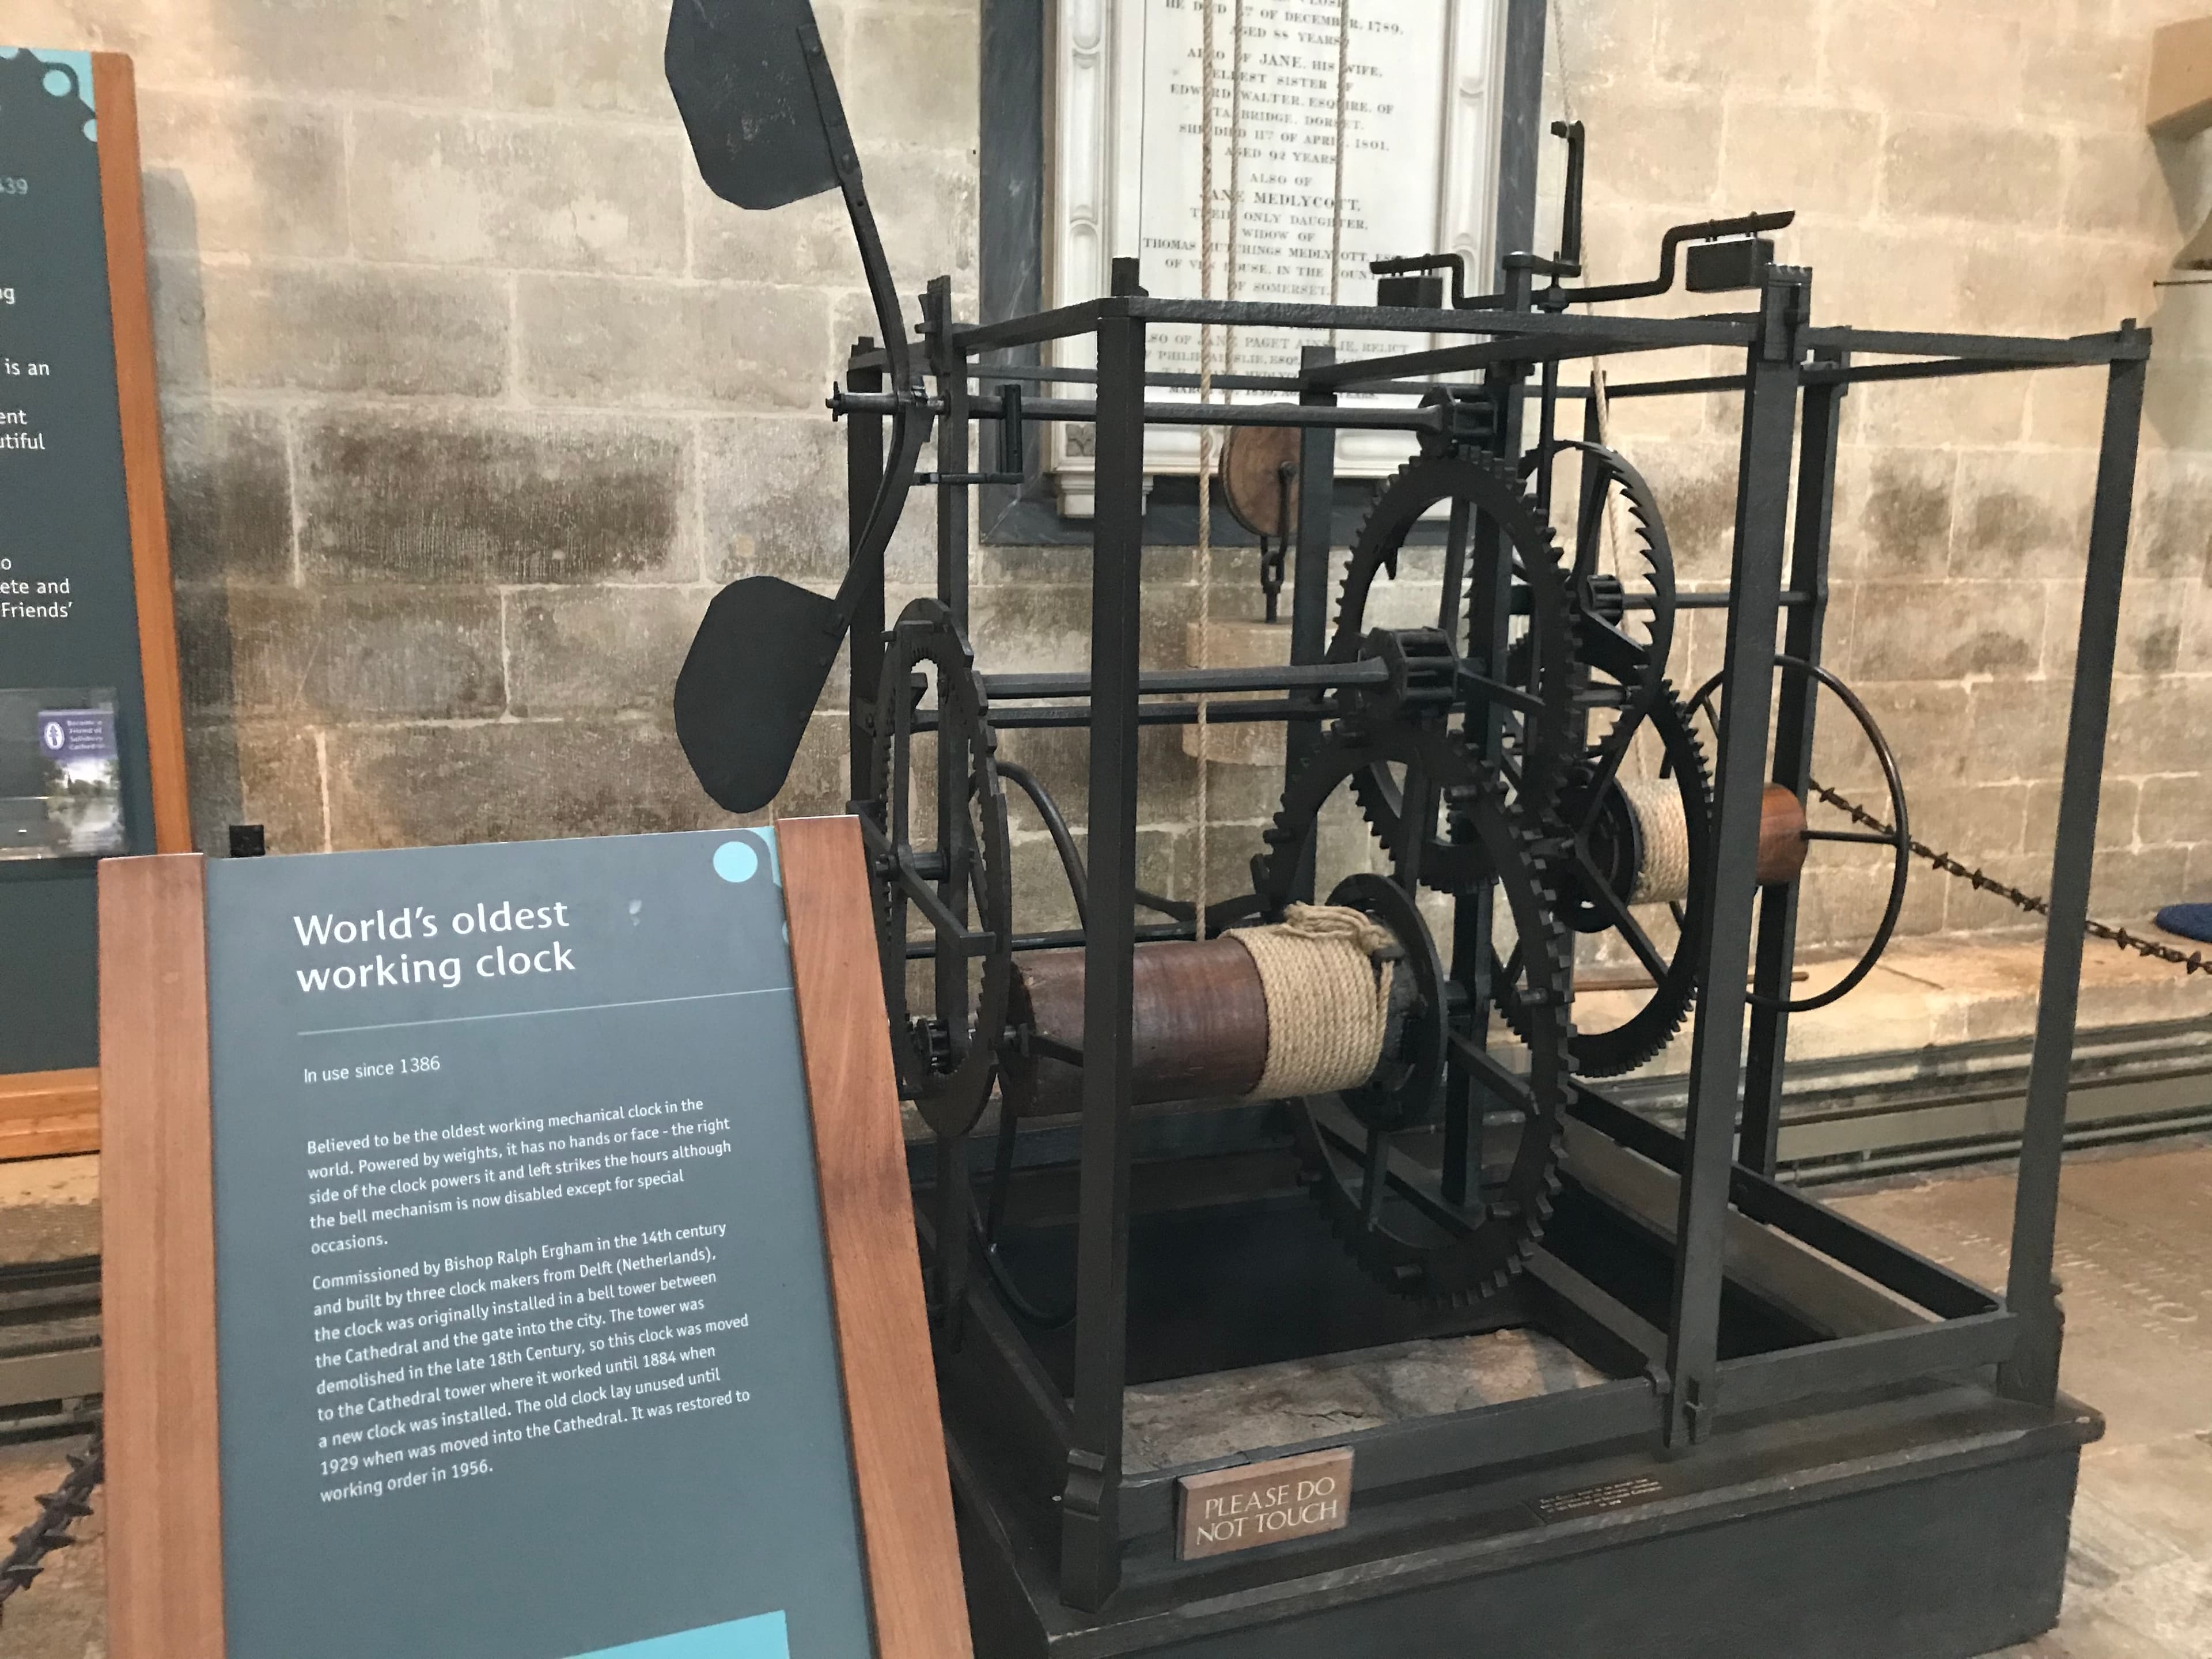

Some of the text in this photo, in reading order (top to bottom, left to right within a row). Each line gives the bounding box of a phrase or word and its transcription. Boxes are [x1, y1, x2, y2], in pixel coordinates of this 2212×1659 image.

[1277, 75, 1327, 89] SISTER
[1312, 60, 1335, 71] HIS
[1249, 173, 1312, 187] ALSO OF
[1241, 228, 1316, 242] WIDOW OF
[1244, 211, 1282, 224] ONLY
[1143, 237, 1196, 251] THOMAS
[1296, 267, 1324, 278] THE
[5, 358, 50, 376] is an
[36, 578, 70, 594] and
[2, 601, 73, 618] Friends'
[293, 901, 569, 946] World's oldest
[296, 941, 575, 993] working clock
[304, 1055, 440, 1083] In use since 1386
[308, 1099, 703, 1154] Believed to be the oldest working mechanical clock in the
[308, 1161, 354, 1179] world.
[359, 1153, 419, 1173] Powered
[423, 1152, 440, 1168] by
[443, 1146, 502, 1164] weights,
[506, 1143, 518, 1156] it
[521, 1141, 544, 1154] has
[548, 1140, 566, 1151] no
[570, 1132, 610, 1148] hands
[614, 1132, 628, 1143] or
[631, 1128, 659, 1141] face
[671, 1122, 694, 1136] the
[698, 1118, 730, 1135] right
[309, 1140, 731, 1204] side of the clock powers it and left strikes the hours although
[310, 1169, 684, 1229] the bell mechanism is now disabled except for special
[311, 1234, 388, 1254] occasions.
[313, 1224, 726, 1290] Commissioned by Bishop Ralph Ergham in the 14th century
[314, 1247, 715, 1316] and built by three clock makers from Delft (Netherlands),
[315, 1273, 716, 1342] the clock was originally installed in a bell tower between
[315, 1300, 704, 1369] the Cathedral and the gate into the city. The tower was
[317, 1346, 715, 1421] to the Cathedral tower where it worked until 1884 when
[320, 1390, 750, 1476] 1929 when was moved into the Cathedral. It was restored to
[320, 1459, 493, 1502] working order in 1956.
[1205, 1476, 1335, 1518] PLEASE DO
[1196, 1499, 1336, 1545] NOT TOUCH
